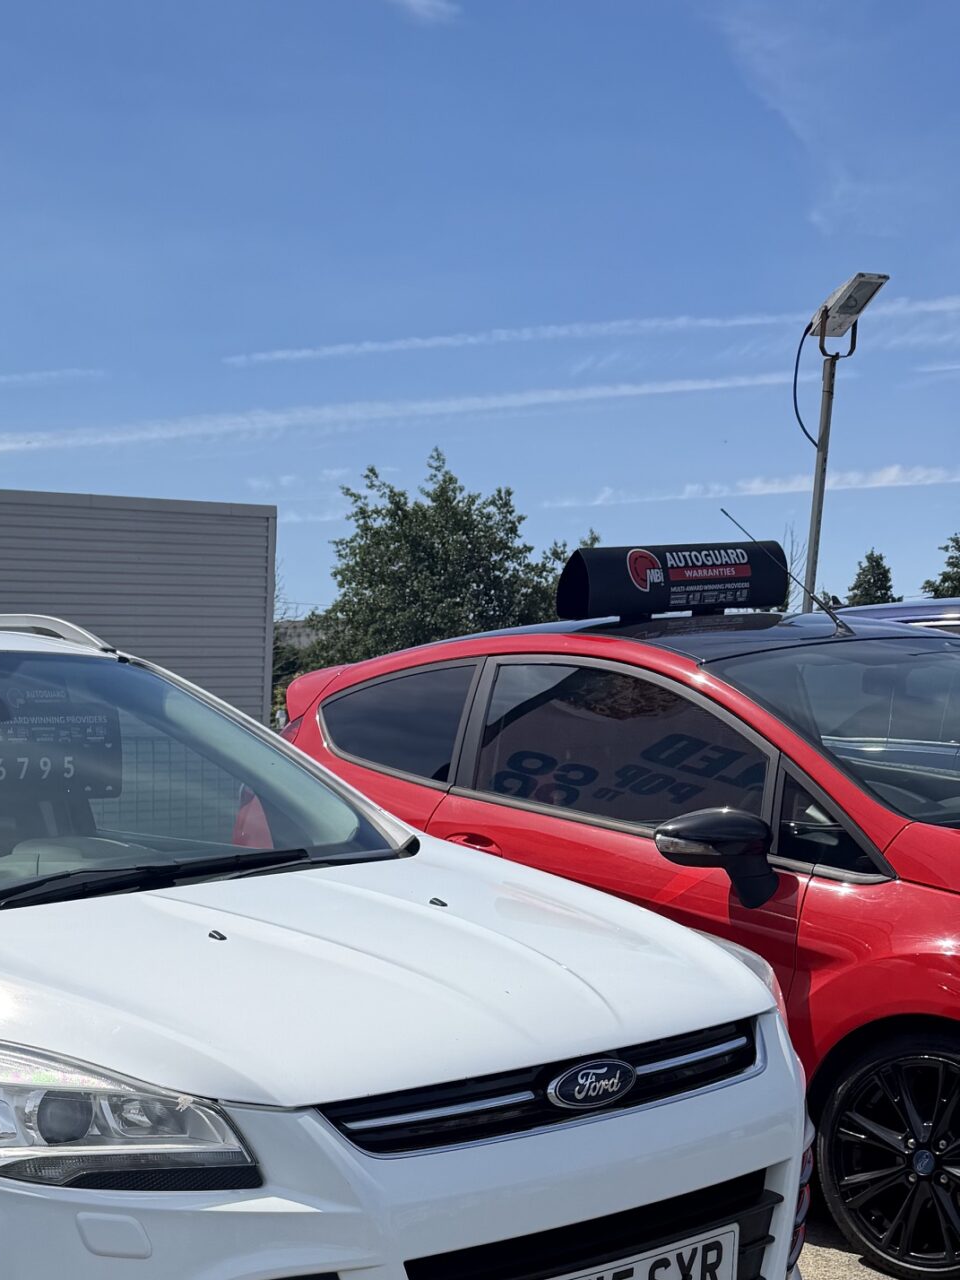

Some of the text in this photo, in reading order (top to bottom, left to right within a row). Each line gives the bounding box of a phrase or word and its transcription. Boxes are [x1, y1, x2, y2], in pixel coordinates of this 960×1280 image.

[665, 548, 749, 568] AUTOGUARD
[684, 567, 736, 578] WARRANTIES
[703, 583, 725, 591] WINNING
[31, 715, 65, 724] WINNING
[66, 714, 108, 724] PROVIDERS
[574, 1066, 621, 1100] Ford
